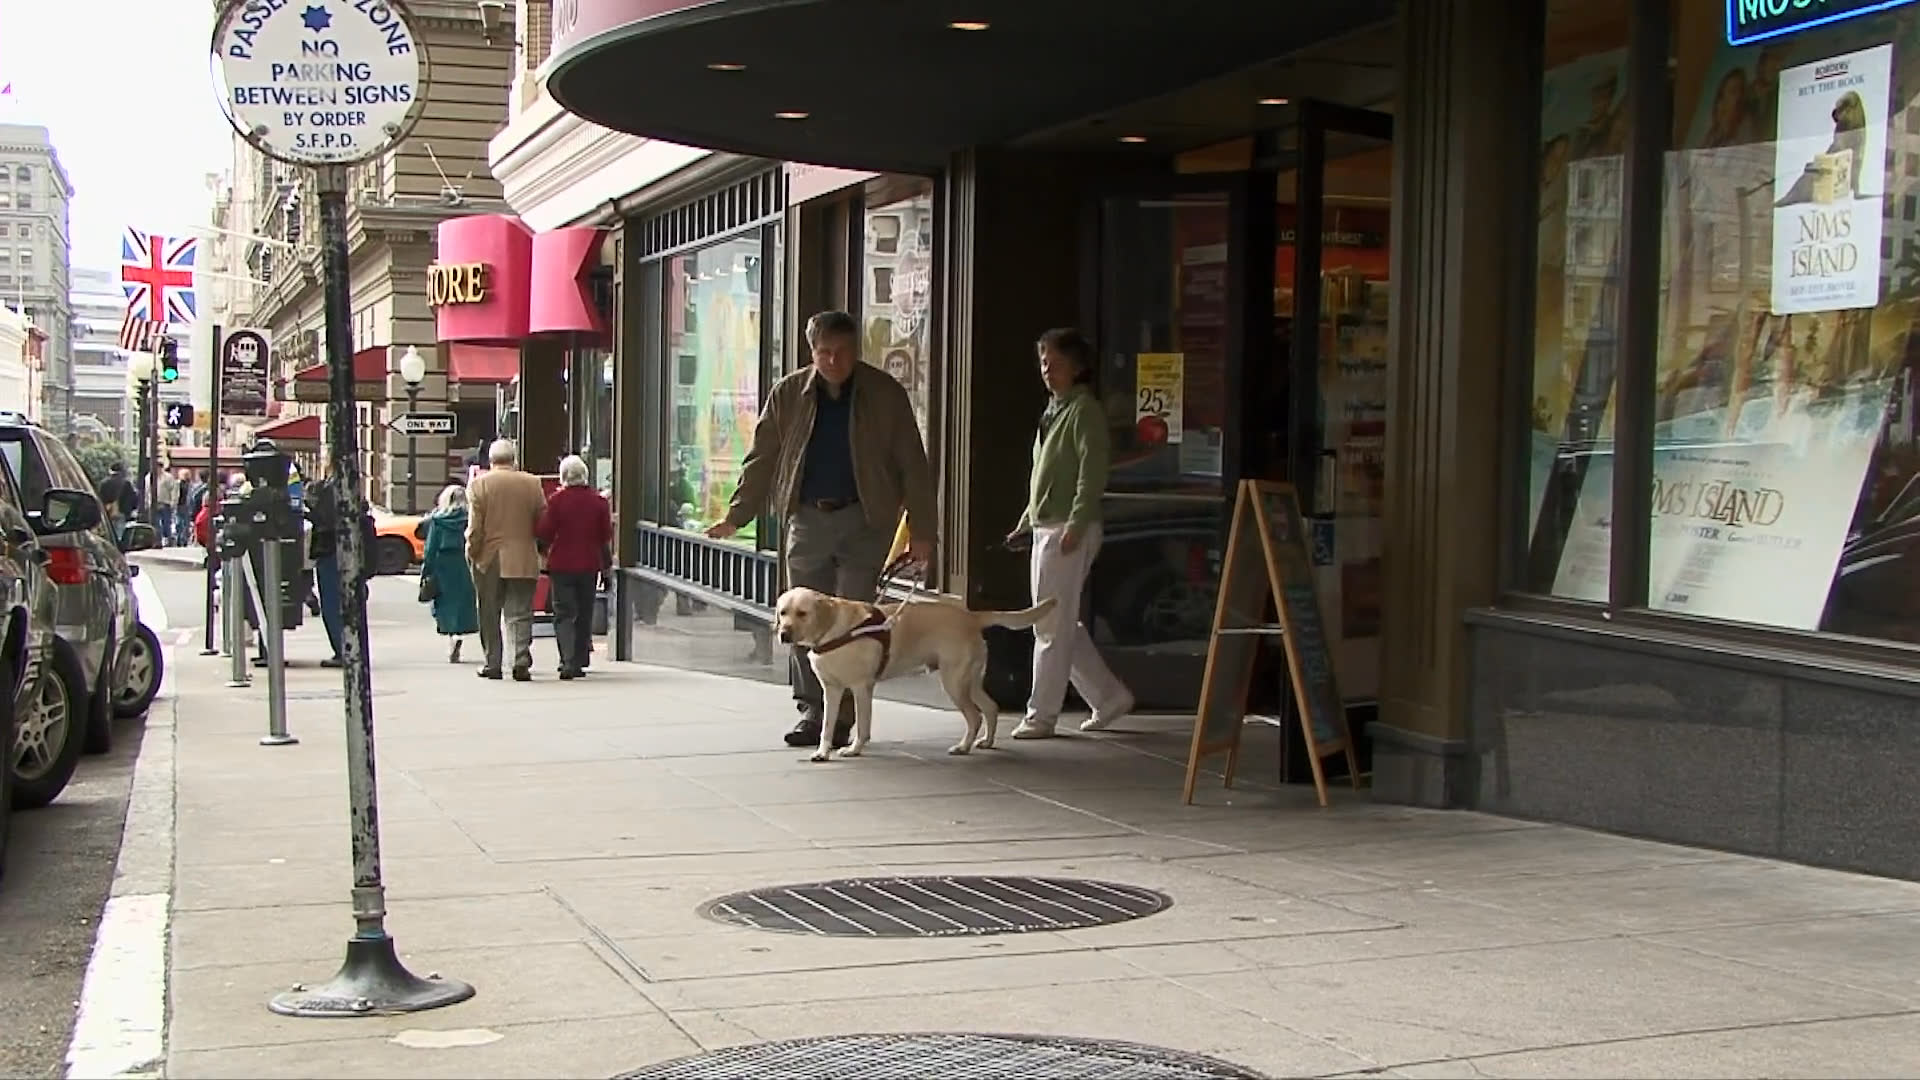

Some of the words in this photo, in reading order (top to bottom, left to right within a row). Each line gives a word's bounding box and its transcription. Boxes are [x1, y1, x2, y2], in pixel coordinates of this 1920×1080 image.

[301, 40, 339, 57] NO
[272, 63, 371, 82] PARKING
[234, 87, 337, 105] BETWEEN
[344, 85, 411, 104] SIGNS
[284, 112, 304, 126] BY
[310, 111, 366, 126] ORDER
[296, 133, 357, 148] S.F.P.D.
[1790, 243, 1858, 278] ISLAND
[427, 263, 485, 306] TORE
[1690, 479, 1785, 528] ISLAND
